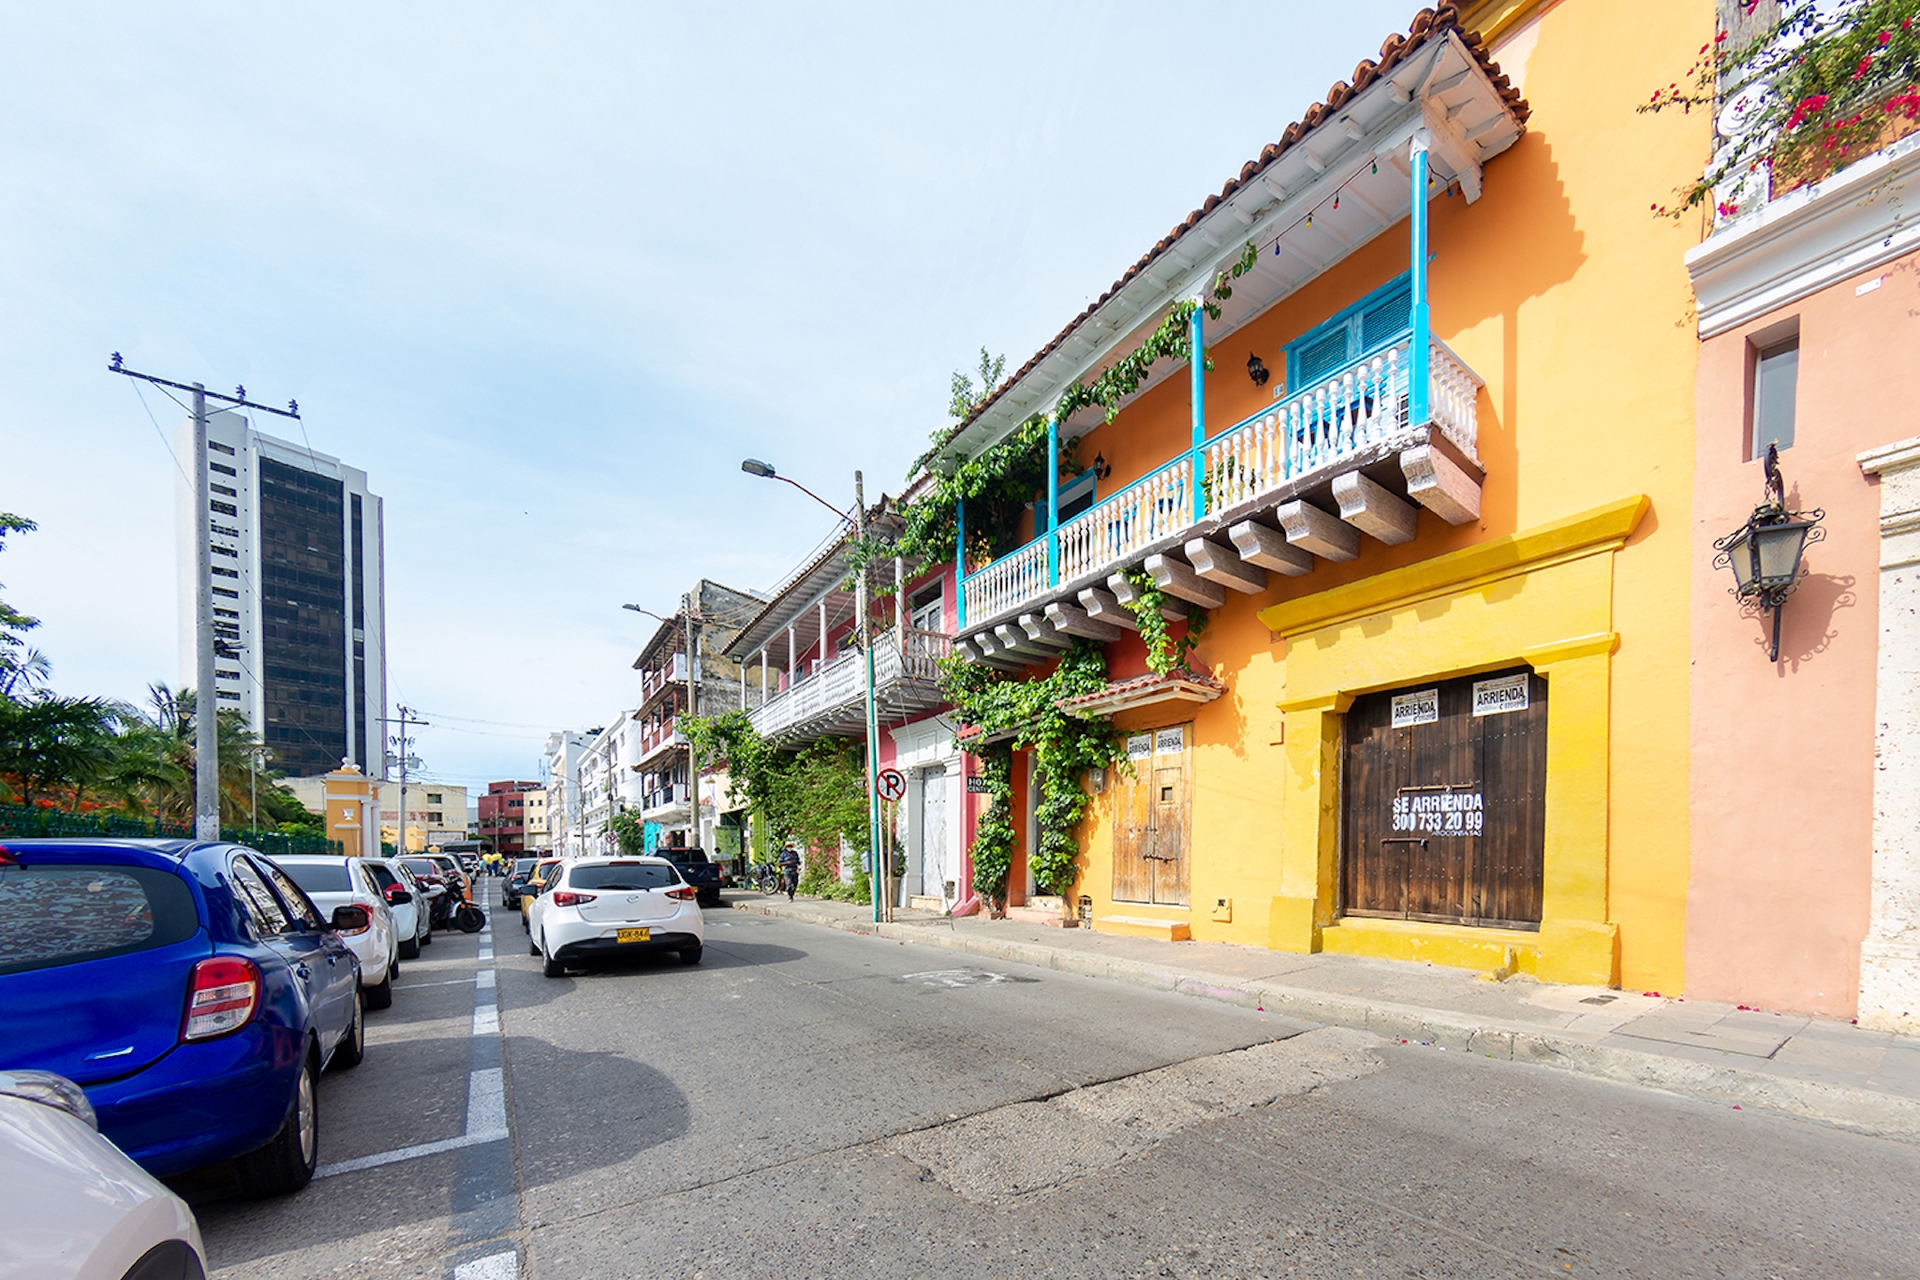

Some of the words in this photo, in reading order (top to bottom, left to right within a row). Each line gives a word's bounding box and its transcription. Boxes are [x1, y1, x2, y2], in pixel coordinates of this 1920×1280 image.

[1476, 686, 1526, 706] ARRIENDA
[1394, 701, 1436, 719] ARRIENDA
[886, 774, 900, 796] P
[1392, 796, 1410, 813] SE
[1411, 793, 1484, 812] ARRIENDA
[1392, 812, 1416, 831] 300
[1418, 812, 1442, 832] 733
[1444, 811, 1463, 830] 20
[1465, 811, 1483, 830] 99
